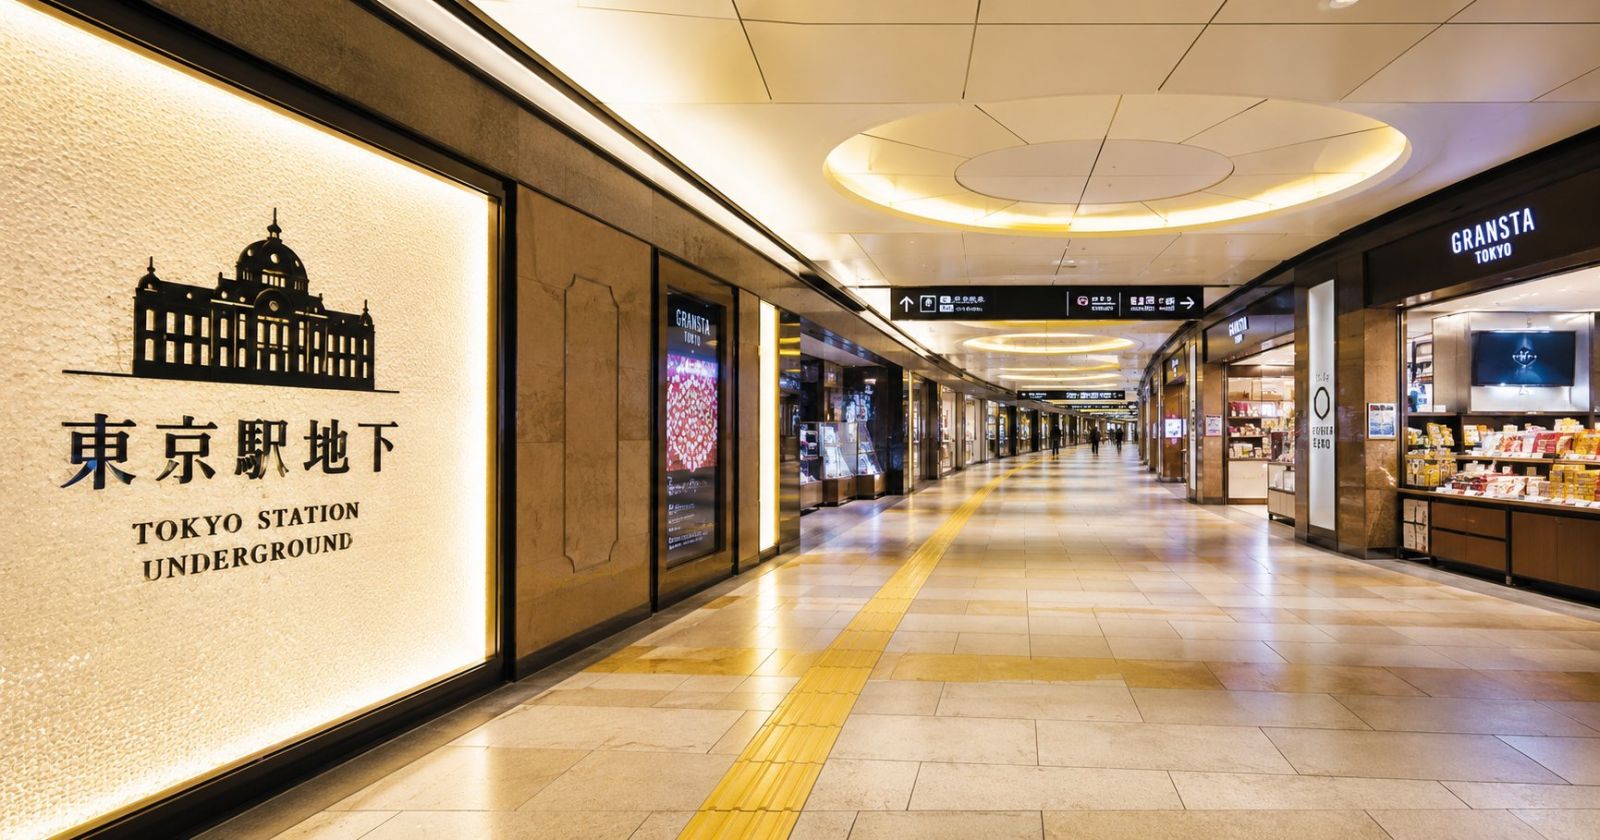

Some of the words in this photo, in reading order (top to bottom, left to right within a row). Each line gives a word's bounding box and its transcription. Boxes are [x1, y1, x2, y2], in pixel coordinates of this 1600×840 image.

[1451, 207, 1536, 254] GRANSTA
[1474, 242, 1512, 265] TOKYO
[675, 308, 711, 337] GRANSTA
[60, 413, 399, 490] 東京駅地下
[132, 513, 243, 545] TOKYO
[258, 501, 360, 530] STATION
[142, 532, 354, 582] UNDERGROUND
